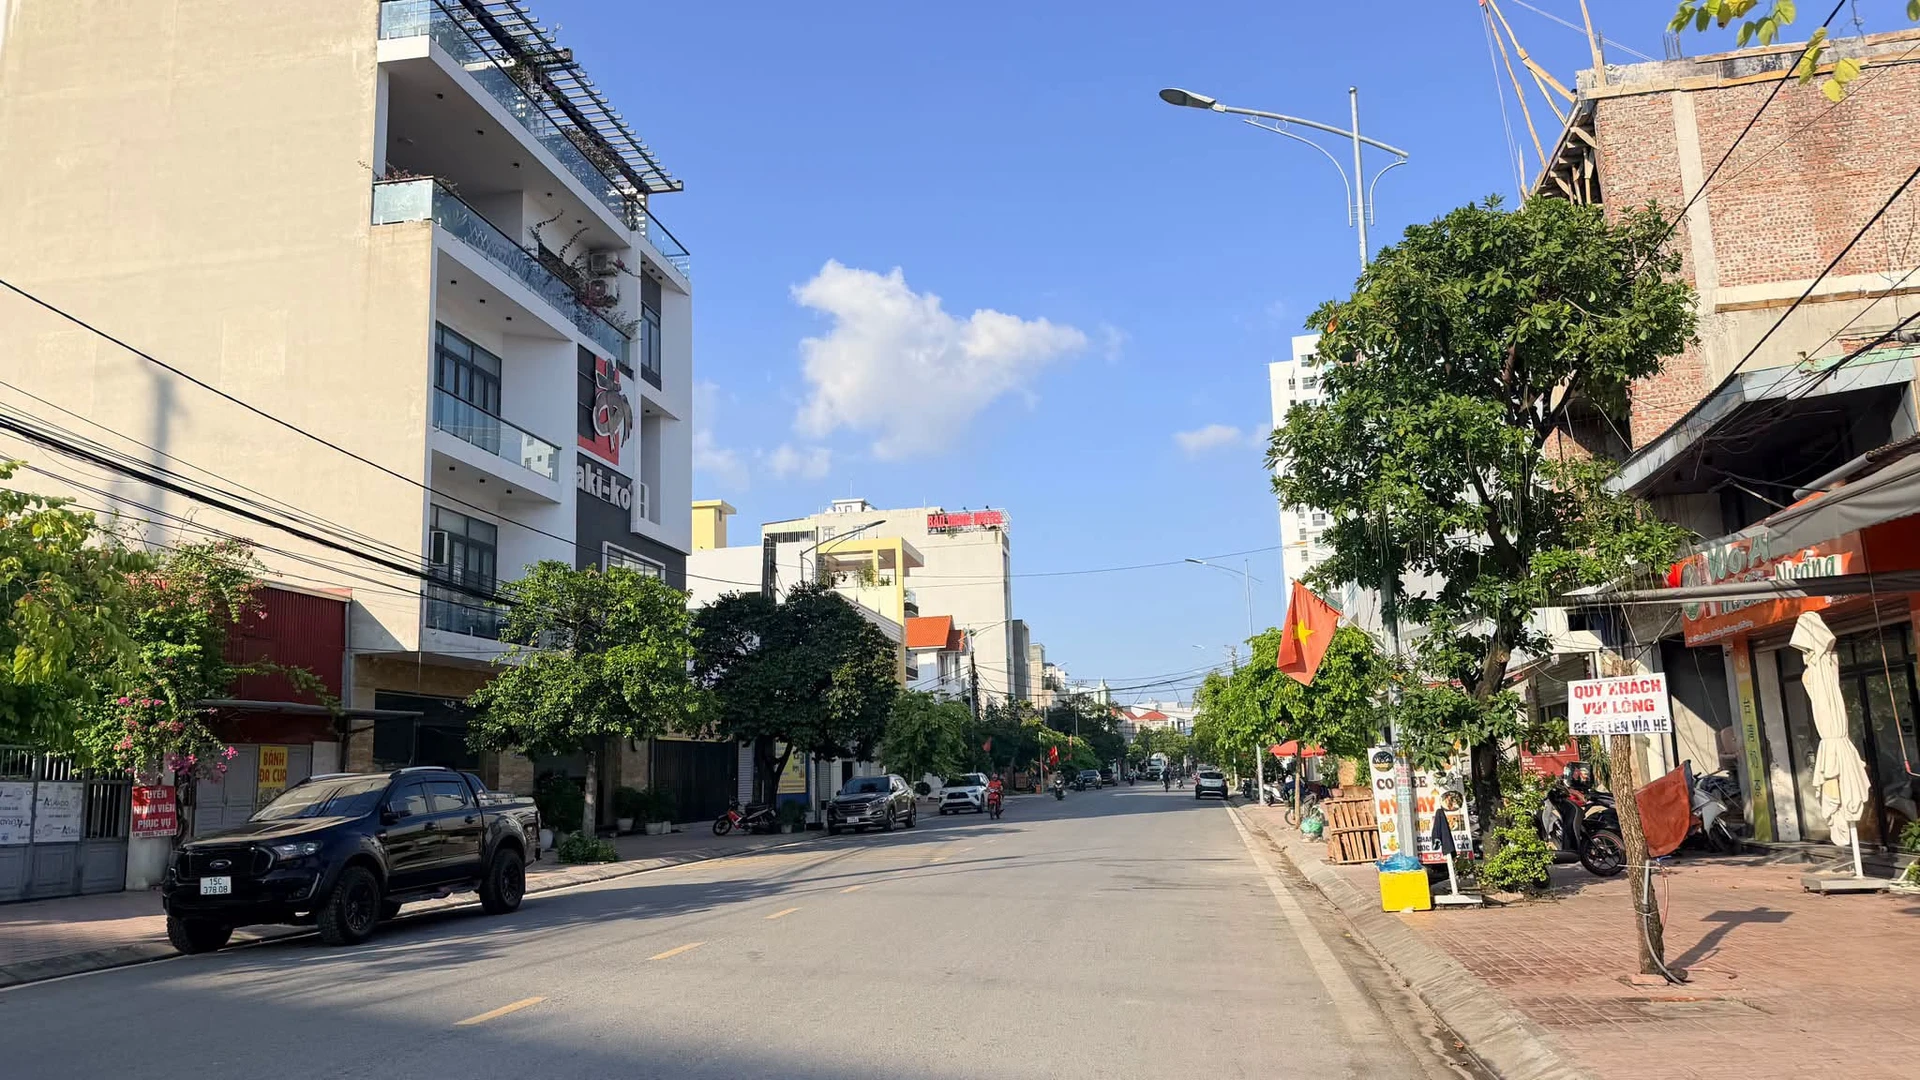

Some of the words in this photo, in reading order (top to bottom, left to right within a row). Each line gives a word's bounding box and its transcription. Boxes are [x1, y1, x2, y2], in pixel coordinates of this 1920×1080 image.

[1574, 681, 1602, 699] QUÝ
[1608, 678, 1662, 696] KHÁCH
[1612, 697, 1655, 713] LÒNG
[1632, 715, 1650, 731] VỈA
[1653, 715, 1668, 731] HÈ
[209, 877, 223, 886] 15C
